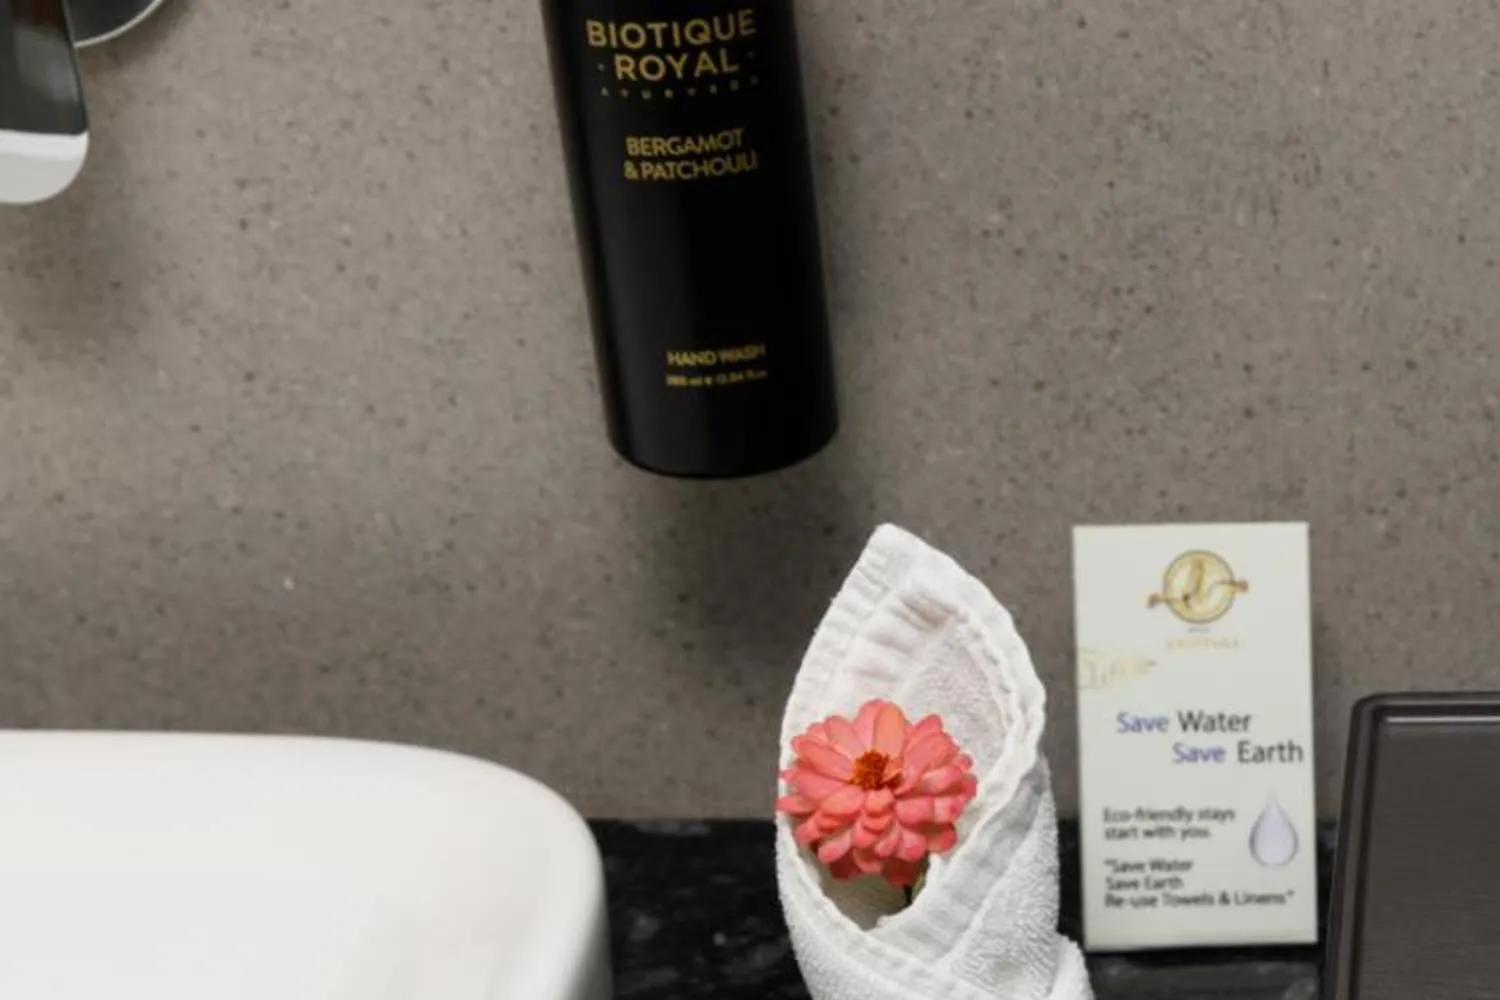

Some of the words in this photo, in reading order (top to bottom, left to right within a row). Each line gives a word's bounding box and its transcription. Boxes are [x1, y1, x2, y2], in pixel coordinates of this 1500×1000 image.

[586, 9, 757, 49] BIOTIQUE
[613, 48, 740, 81] ROYAL
[625, 128, 744, 156] BERGAMOT
[666, 350, 717, 366] HAND
[1116, 711, 1169, 734] Save
[1176, 709, 1252, 733] Water
[1172, 741, 1227, 764] Save
[1237, 739, 1304, 764] Earth
[1103, 806, 1193, 825] Eco-friendly
[1197, 808, 1236, 825] stays
[1104, 826, 1138, 840] start
[1142, 825, 1176, 840] with
[1149, 858, 1194, 872] Water
[1105, 876, 1140, 891] Save
[1143, 875, 1184, 890] Earth
[1104, 893, 1158, 908] Re-use
[1162, 891, 1215, 906] Towels
[1219, 890, 1231, 905] &
